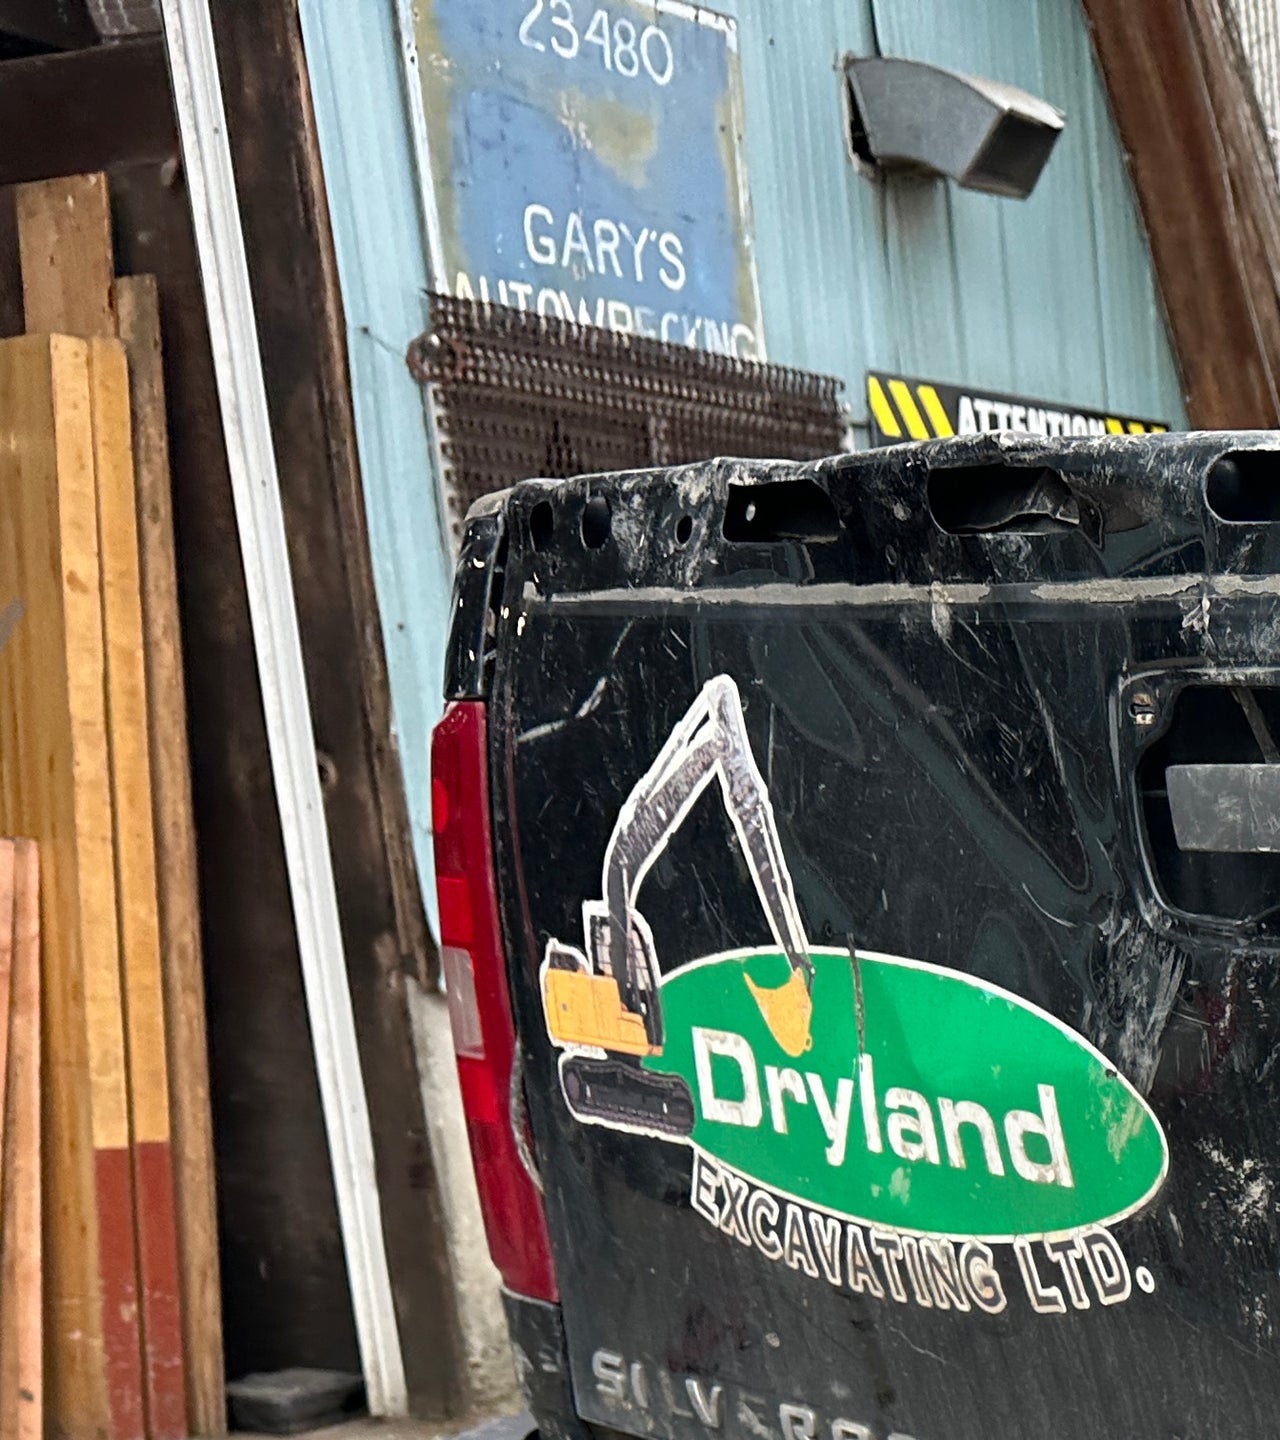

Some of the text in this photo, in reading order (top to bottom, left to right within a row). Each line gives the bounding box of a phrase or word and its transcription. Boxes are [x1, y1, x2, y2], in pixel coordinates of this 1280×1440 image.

[519, 0, 674, 86] 23480
[523, 203, 686, 292] GARY'S
[691, 1026, 1074, 1188] Dryland
[690, 1146, 1155, 1314] EXCAVATING LTD.
